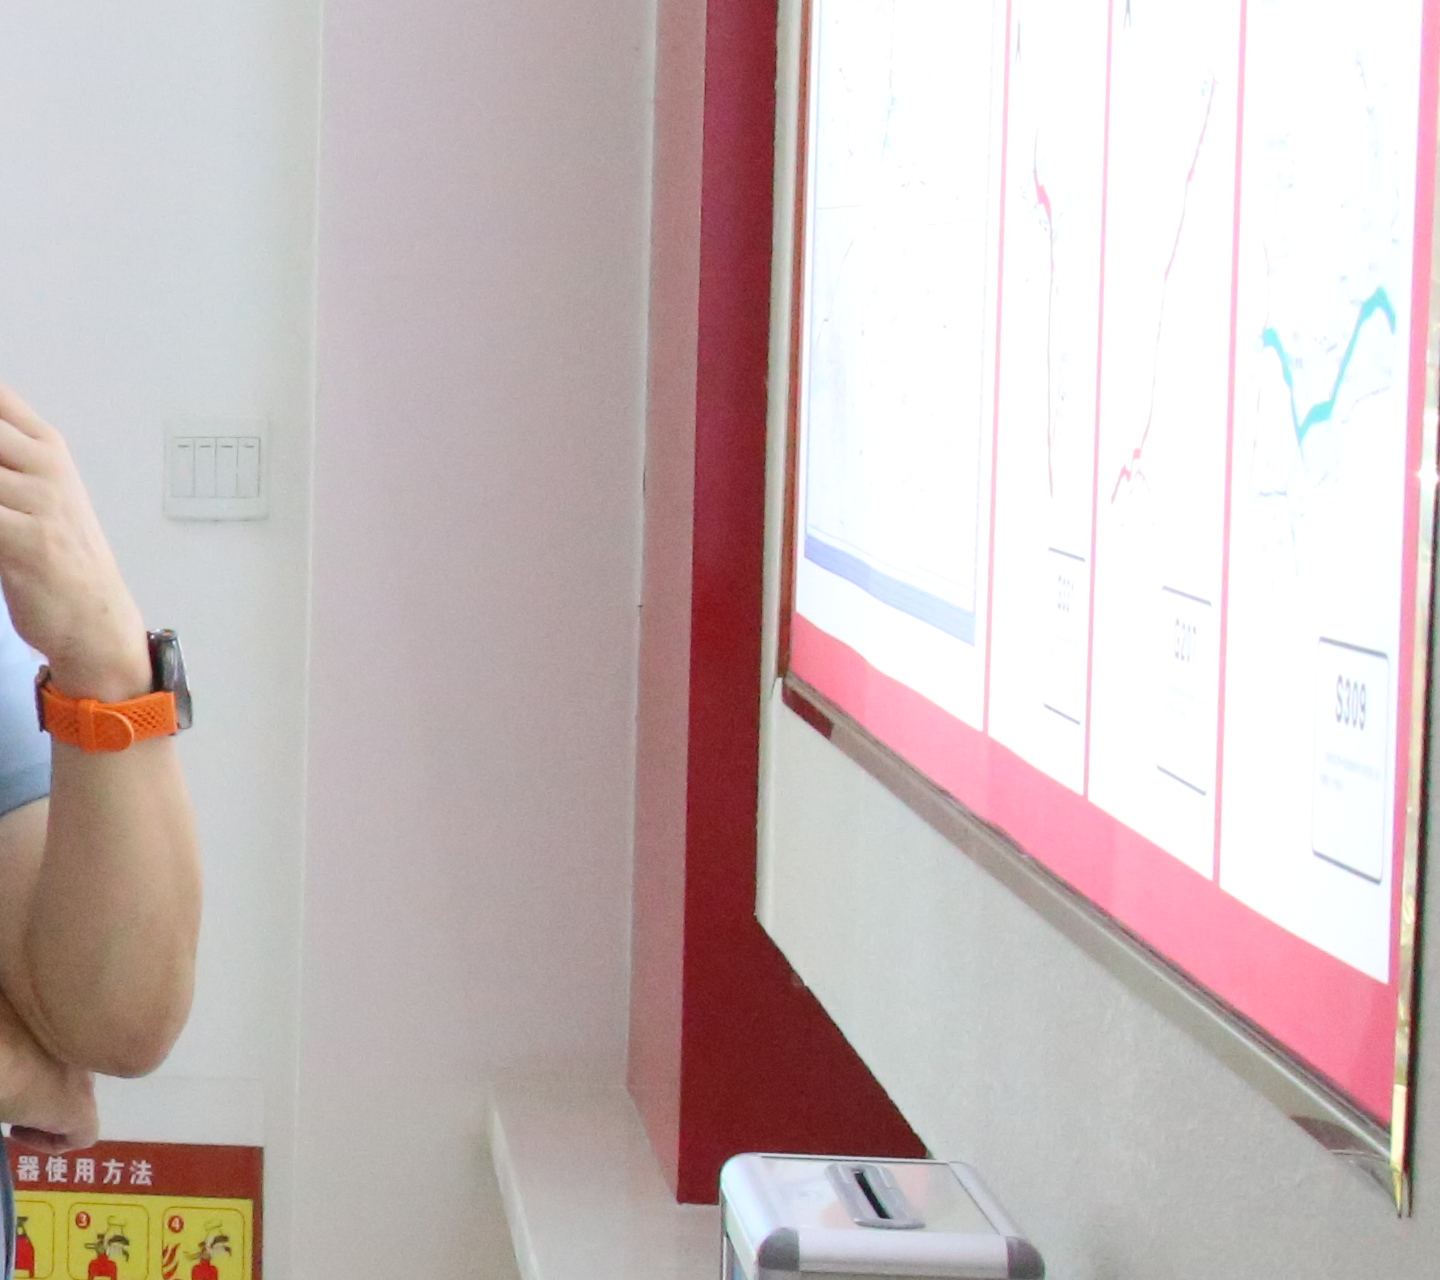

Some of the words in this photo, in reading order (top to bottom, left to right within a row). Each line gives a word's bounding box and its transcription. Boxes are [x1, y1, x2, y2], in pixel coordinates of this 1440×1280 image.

[1335, 674, 1367, 732] S309
[16, 1155, 154, 1187] 器使用方法
